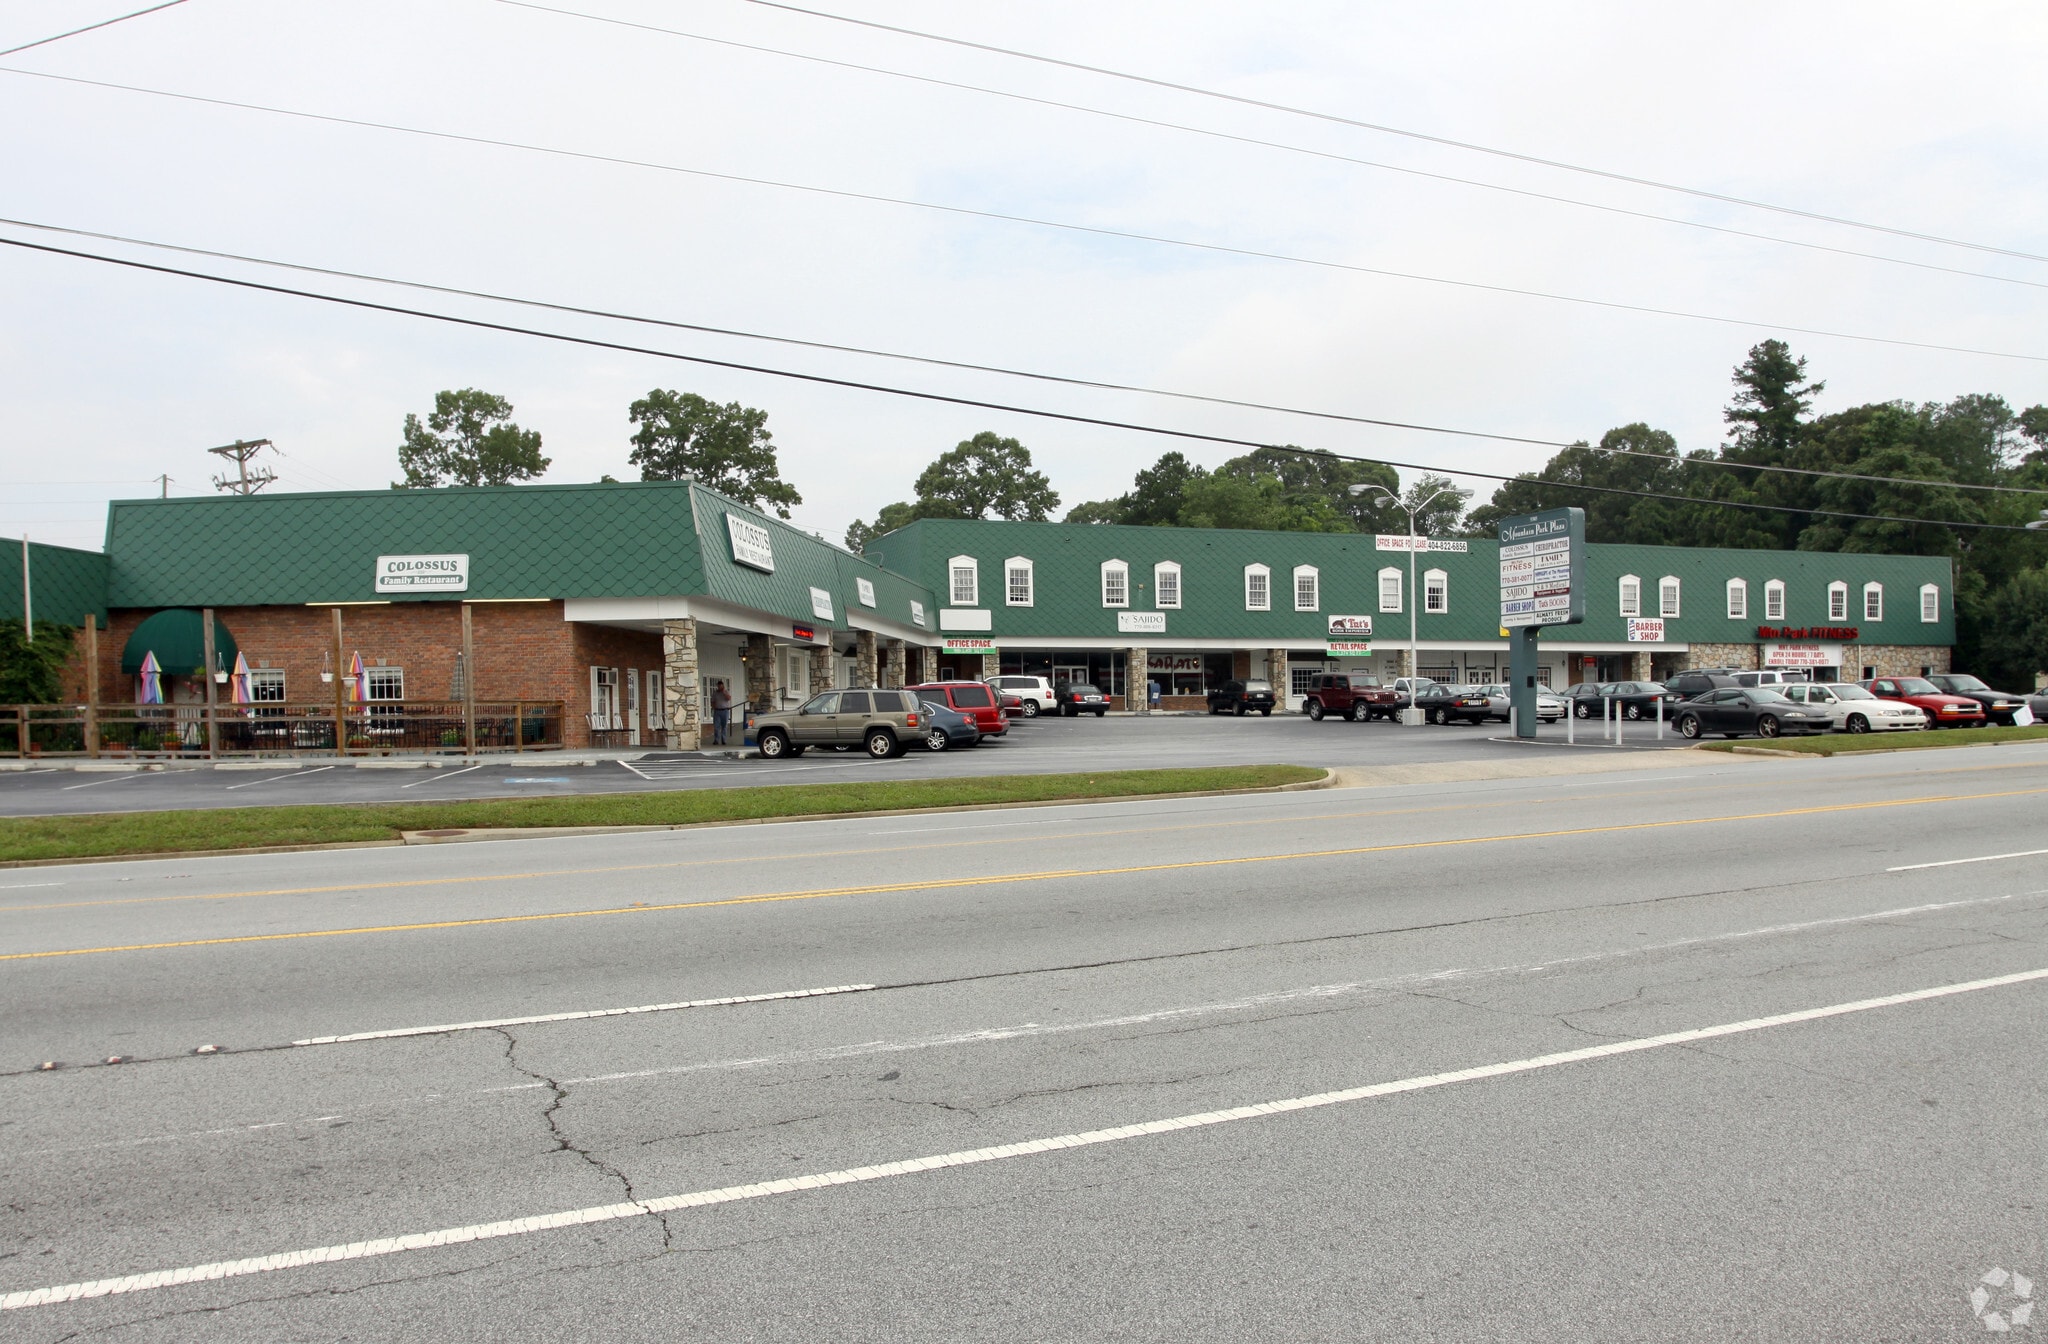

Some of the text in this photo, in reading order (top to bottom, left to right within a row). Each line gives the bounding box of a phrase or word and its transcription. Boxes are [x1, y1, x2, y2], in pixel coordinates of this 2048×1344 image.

[731, 519, 770, 551] COLOSSUS
[1501, 520, 1565, 542] Mountain Park Plaza
[1377, 539, 1390, 547] OFFICE
[1391, 539, 1404, 548] SPACE
[1414, 540, 1427, 548] LEASE
[1428, 541, 1467, 551] 404-822-6856
[1535, 540, 1568, 552] CHIROPRACTOR
[1504, 545, 1528, 553] COLOSSUS
[387, 560, 458, 573] COLOSSUS
[1502, 562, 1532, 572] FITNESS
[384, 576, 459, 586] Family Restaurant
[1506, 586, 1528, 598] SAJIDO
[1505, 602, 1520, 613] BARBER
[1348, 618, 1369, 628] Tut's
[1635, 622, 1663, 631] BARBER
[1640, 632, 1659, 640] SHOP
[1782, 626, 1808, 639] Park
[1811, 627, 1859, 639] FITNESS
[947, 640, 991, 648] OFFICE SPACE
